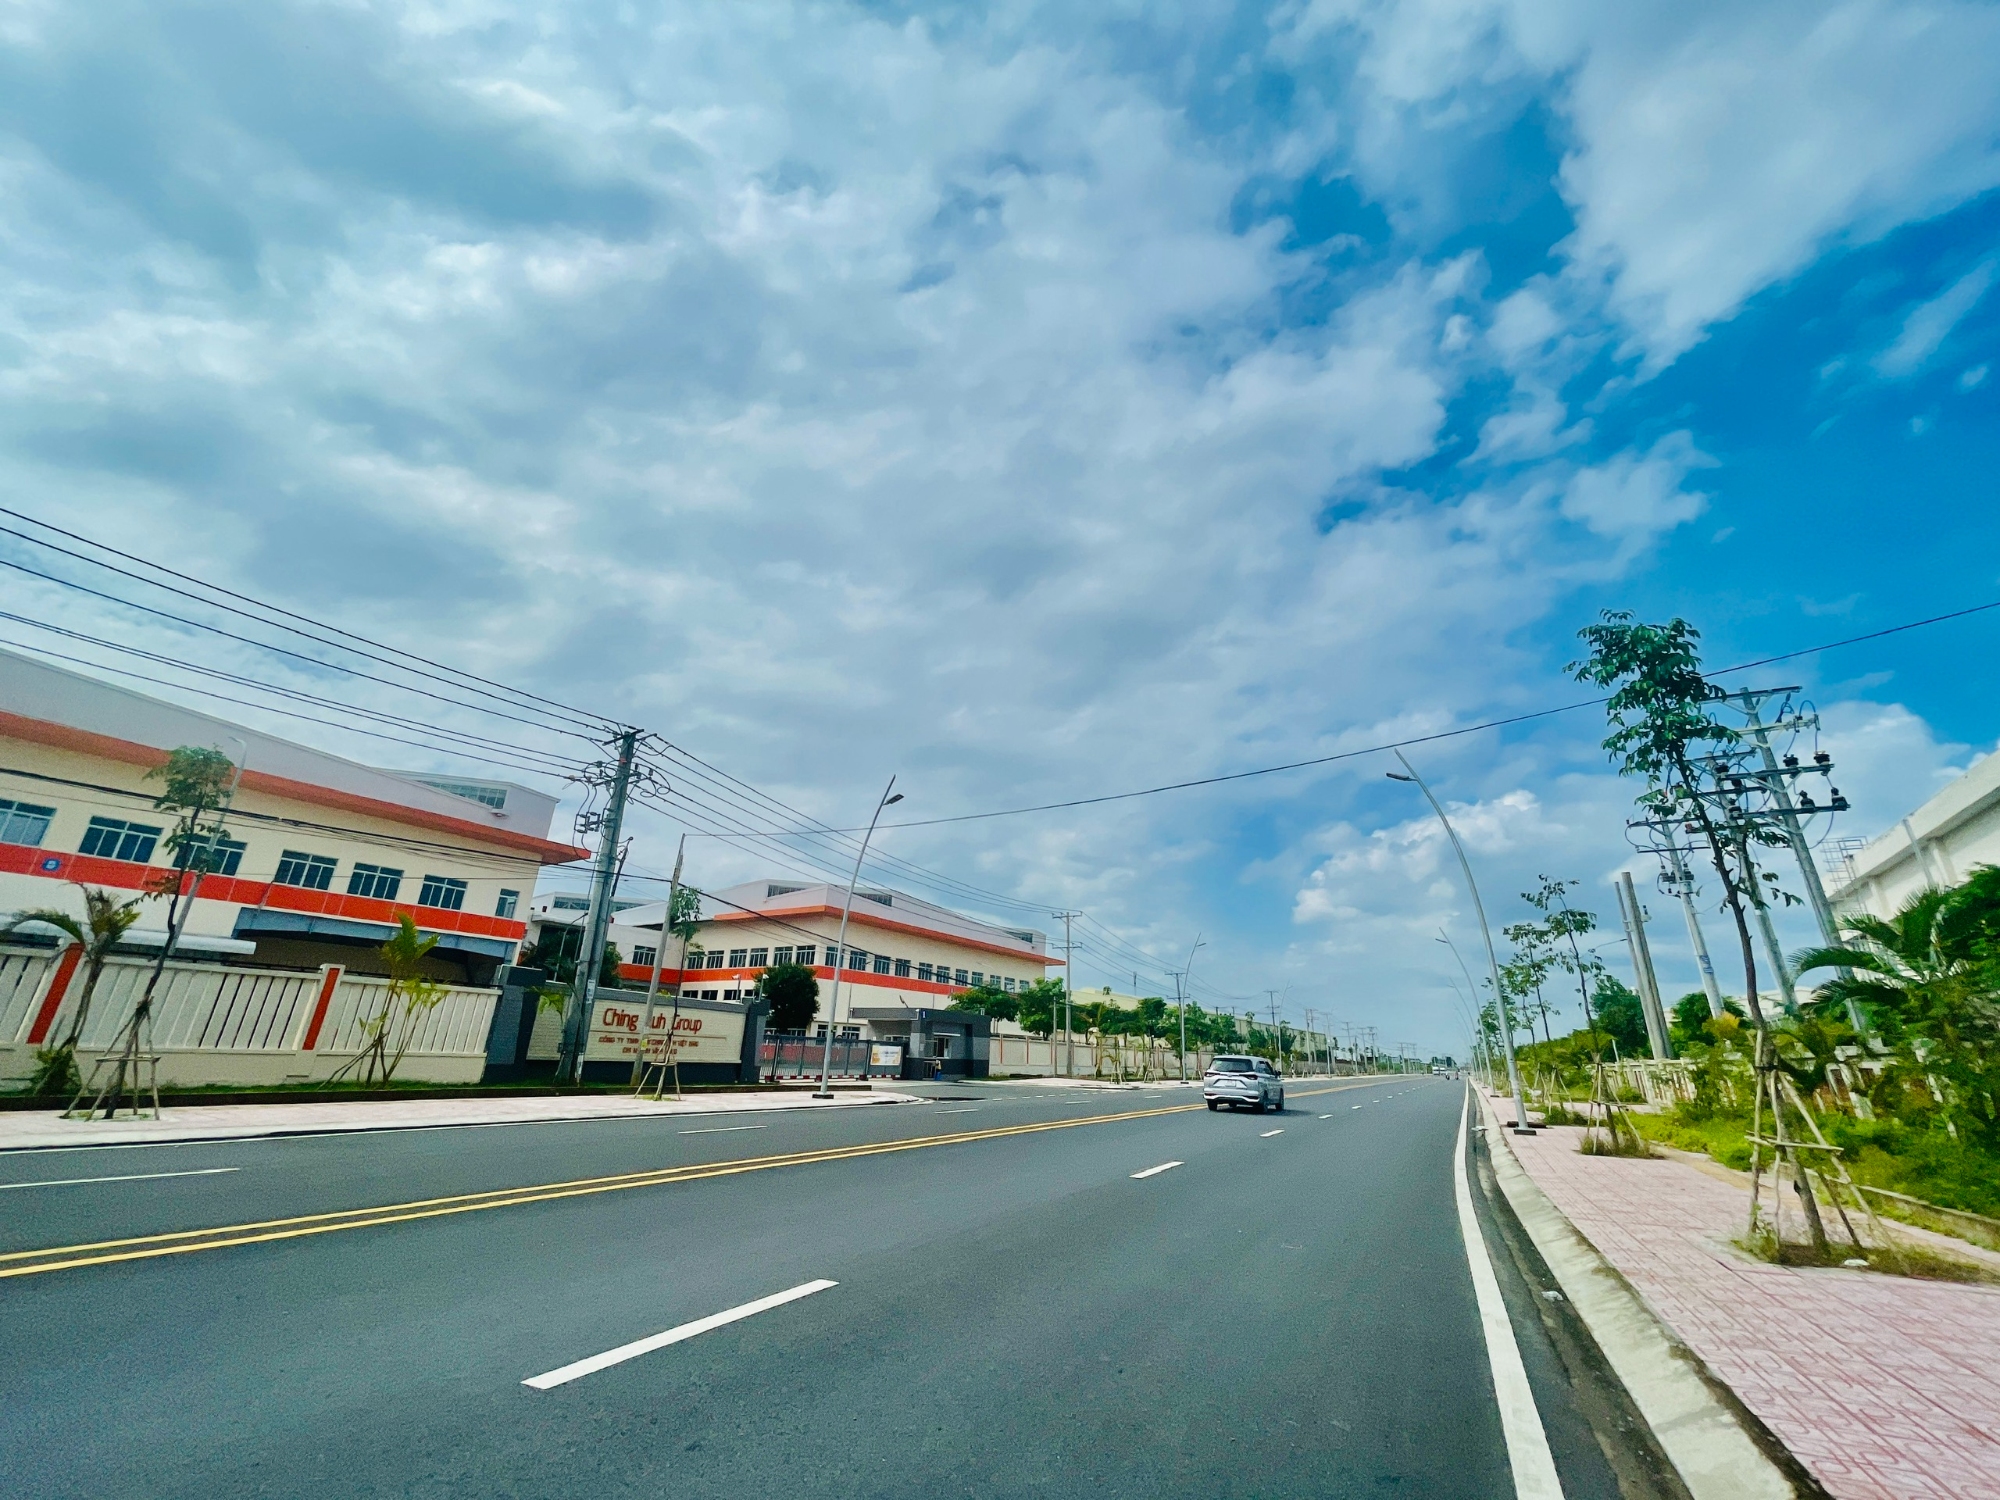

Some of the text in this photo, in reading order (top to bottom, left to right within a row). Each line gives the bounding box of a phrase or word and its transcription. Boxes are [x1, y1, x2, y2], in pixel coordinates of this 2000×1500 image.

[603, 1008, 702, 1034] Ching uh Group
